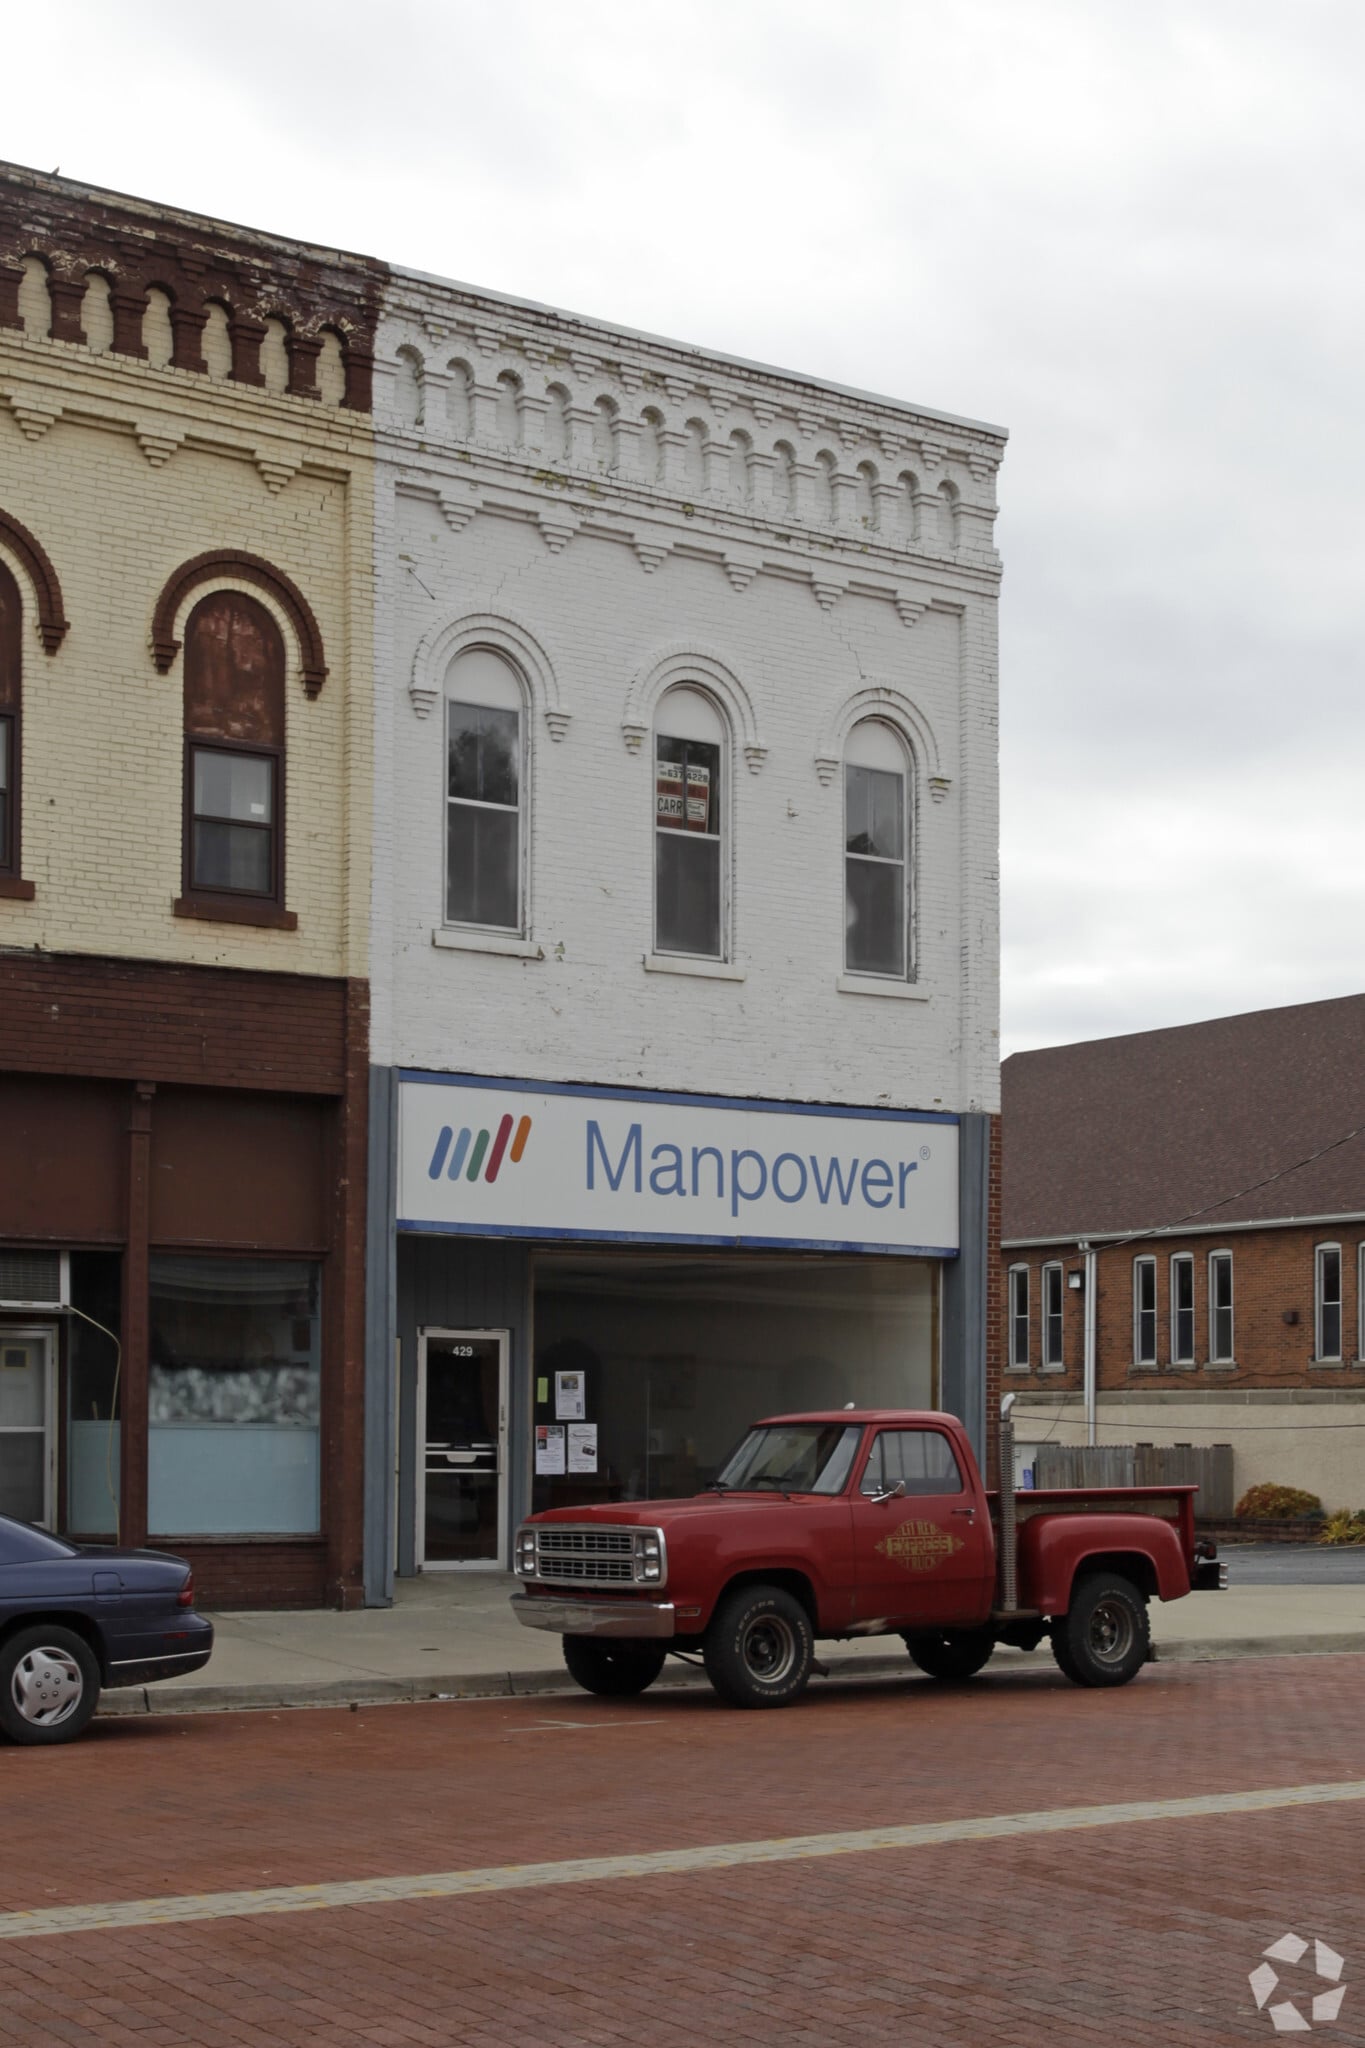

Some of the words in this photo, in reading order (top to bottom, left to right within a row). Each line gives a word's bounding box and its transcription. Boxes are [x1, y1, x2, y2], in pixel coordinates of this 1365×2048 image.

[586, 1120, 917, 1216] Manpower
[452, 1346, 473, 1357] 429
[892, 1537, 948, 1554] EXPRESS
[904, 1555, 937, 1570] TRUCK
